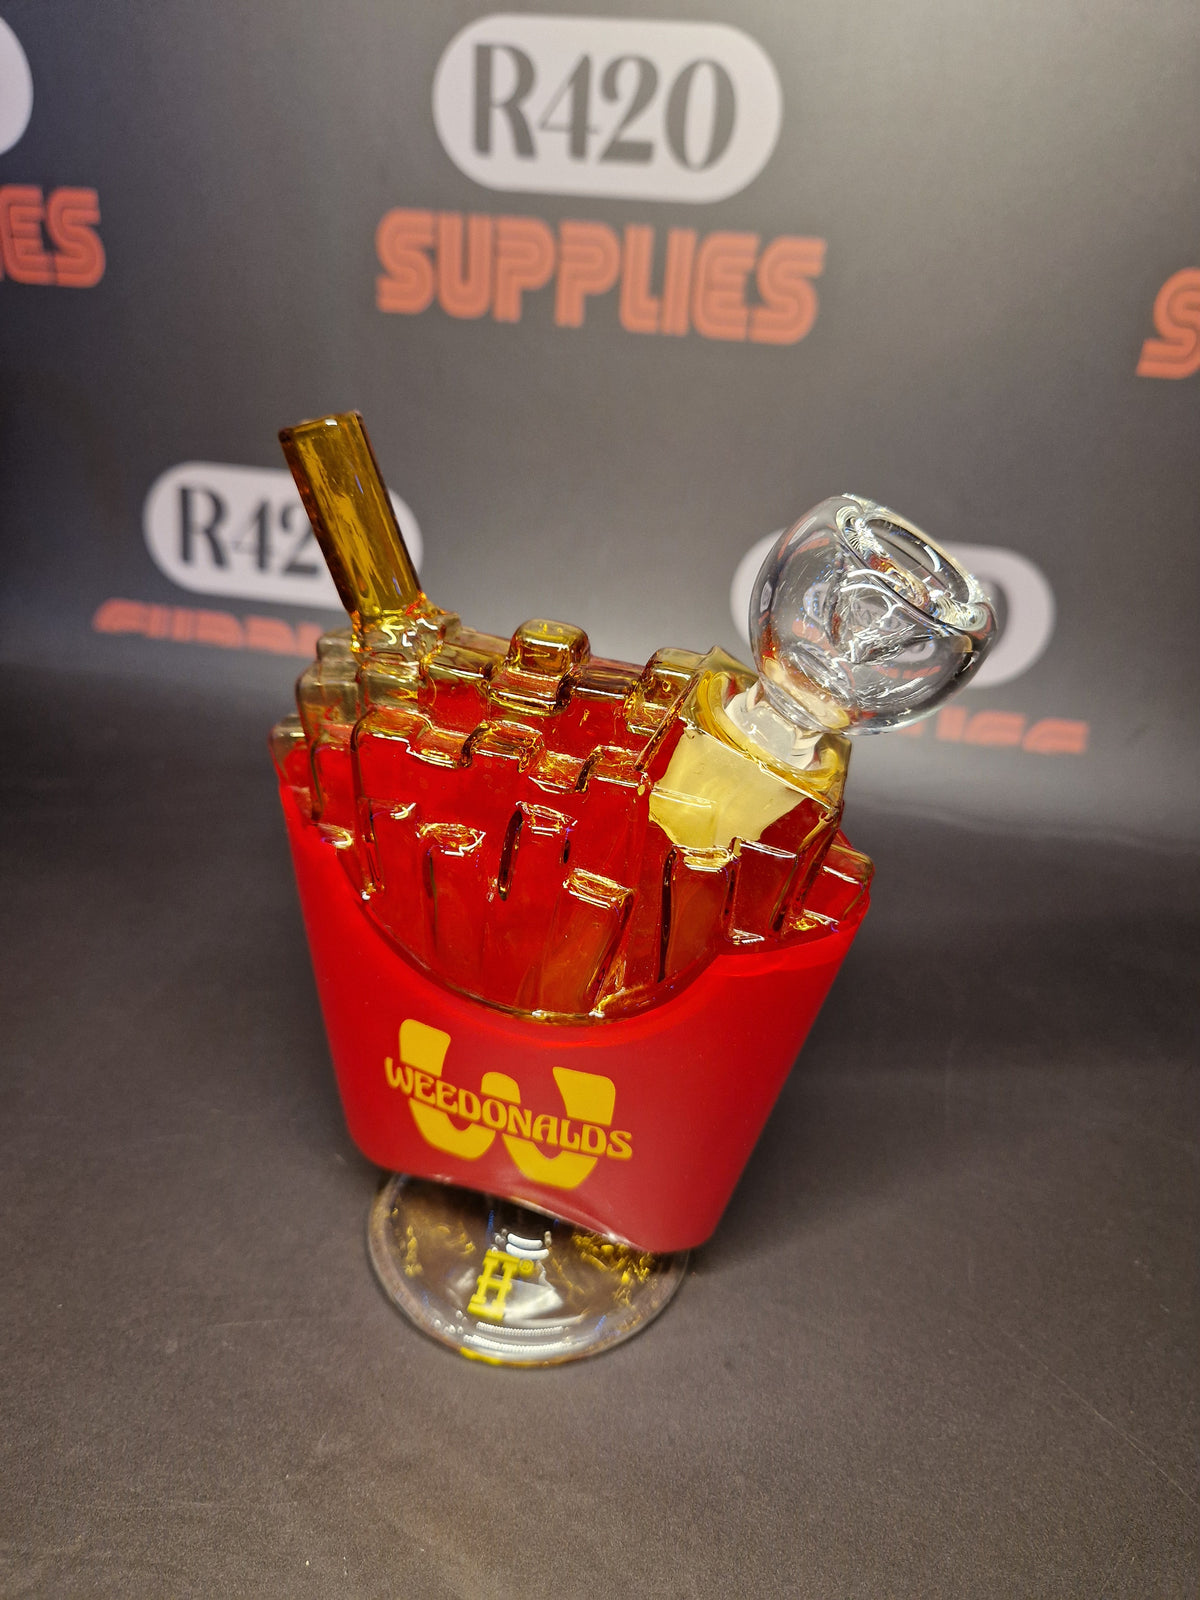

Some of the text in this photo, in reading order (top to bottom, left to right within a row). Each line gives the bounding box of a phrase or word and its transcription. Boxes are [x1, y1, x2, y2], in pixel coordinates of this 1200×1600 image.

[472, 42, 738, 173] R420
[0, 185, 106, 288] ES
[375, 207, 828, 346] SUPPLIES
[177, 485, 321, 576] R42
[384, 1056, 633, 1160] WEEDONALDS
